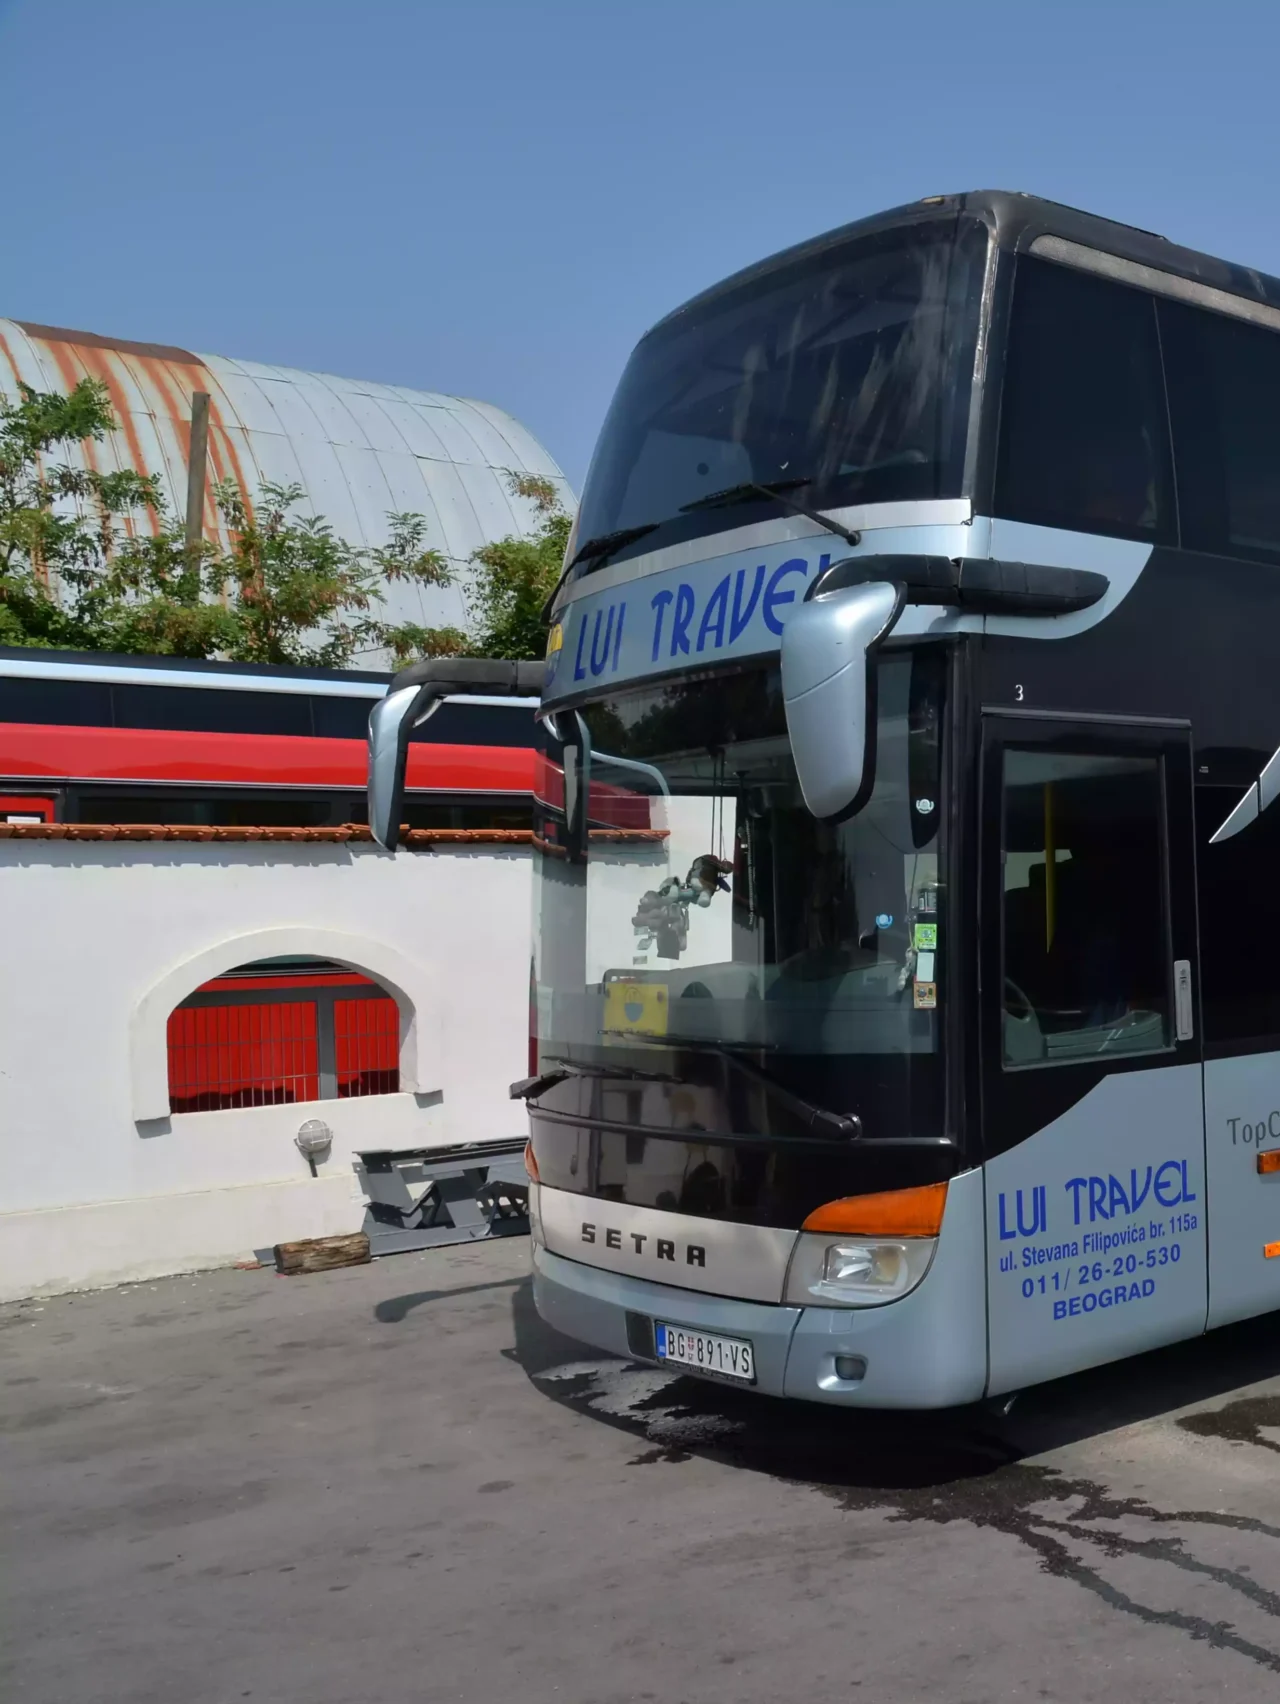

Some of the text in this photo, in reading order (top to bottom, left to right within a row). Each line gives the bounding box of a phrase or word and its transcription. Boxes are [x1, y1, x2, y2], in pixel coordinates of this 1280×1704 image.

[574, 553, 830, 681] LUI TRAVE
[1015, 684, 1024, 701] 3
[999, 1159, 1197, 1241] LUI TRAVEL
[581, 1222, 706, 1268] SETRA
[1000, 1213, 1198, 1272] ul. Stevana Filipovića br. 115a
[1022, 1243, 1182, 1298] 011/ 26-20-530
[1053, 1278, 1156, 1321] BEOGRAD
[668, 1330, 685, 1358] BG
